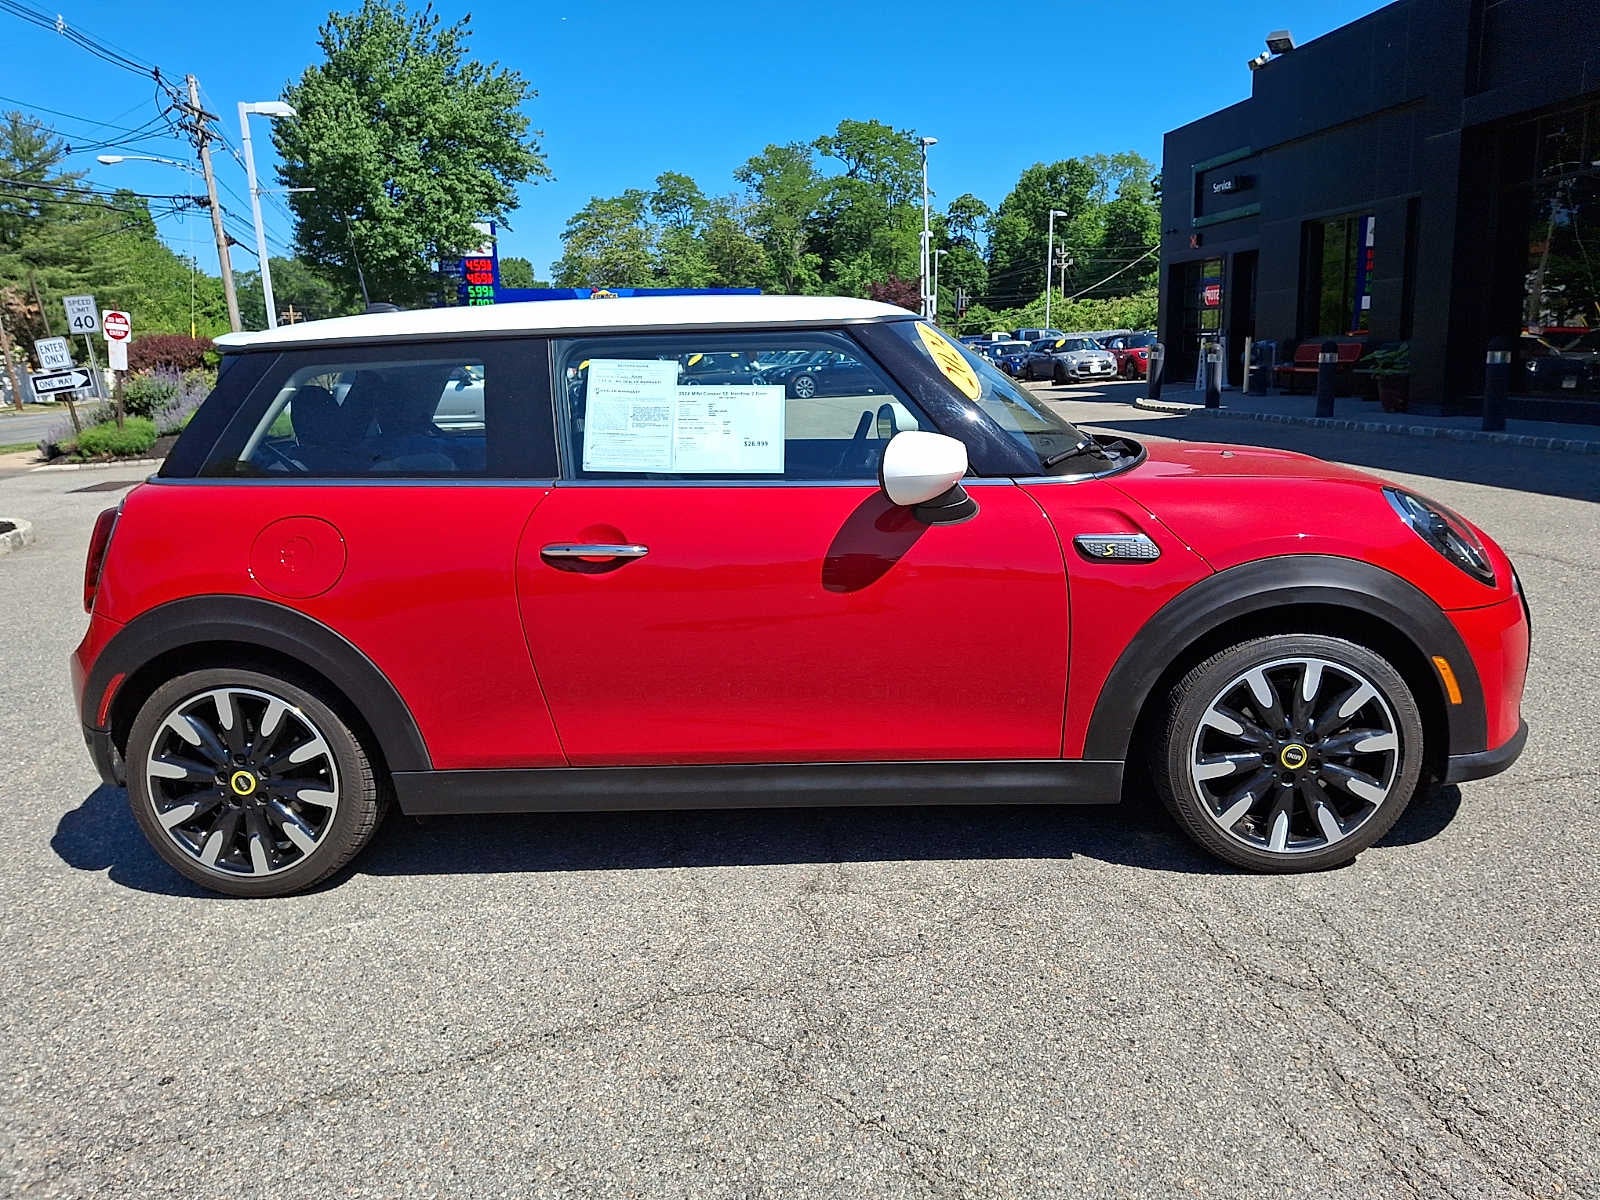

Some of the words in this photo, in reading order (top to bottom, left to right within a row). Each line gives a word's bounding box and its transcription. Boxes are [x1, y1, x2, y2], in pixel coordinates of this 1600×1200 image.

[1212, 180, 1232, 193] Service
[71, 306, 90, 314] LIMIT
[73, 315, 95, 329] 40
[40, 342, 65, 354] ENTER
[44, 355, 65, 365] ONLY
[39, 379, 54, 389] ONE
[57, 376, 73, 386] WAY
[1103, 543, 1116, 556] S
